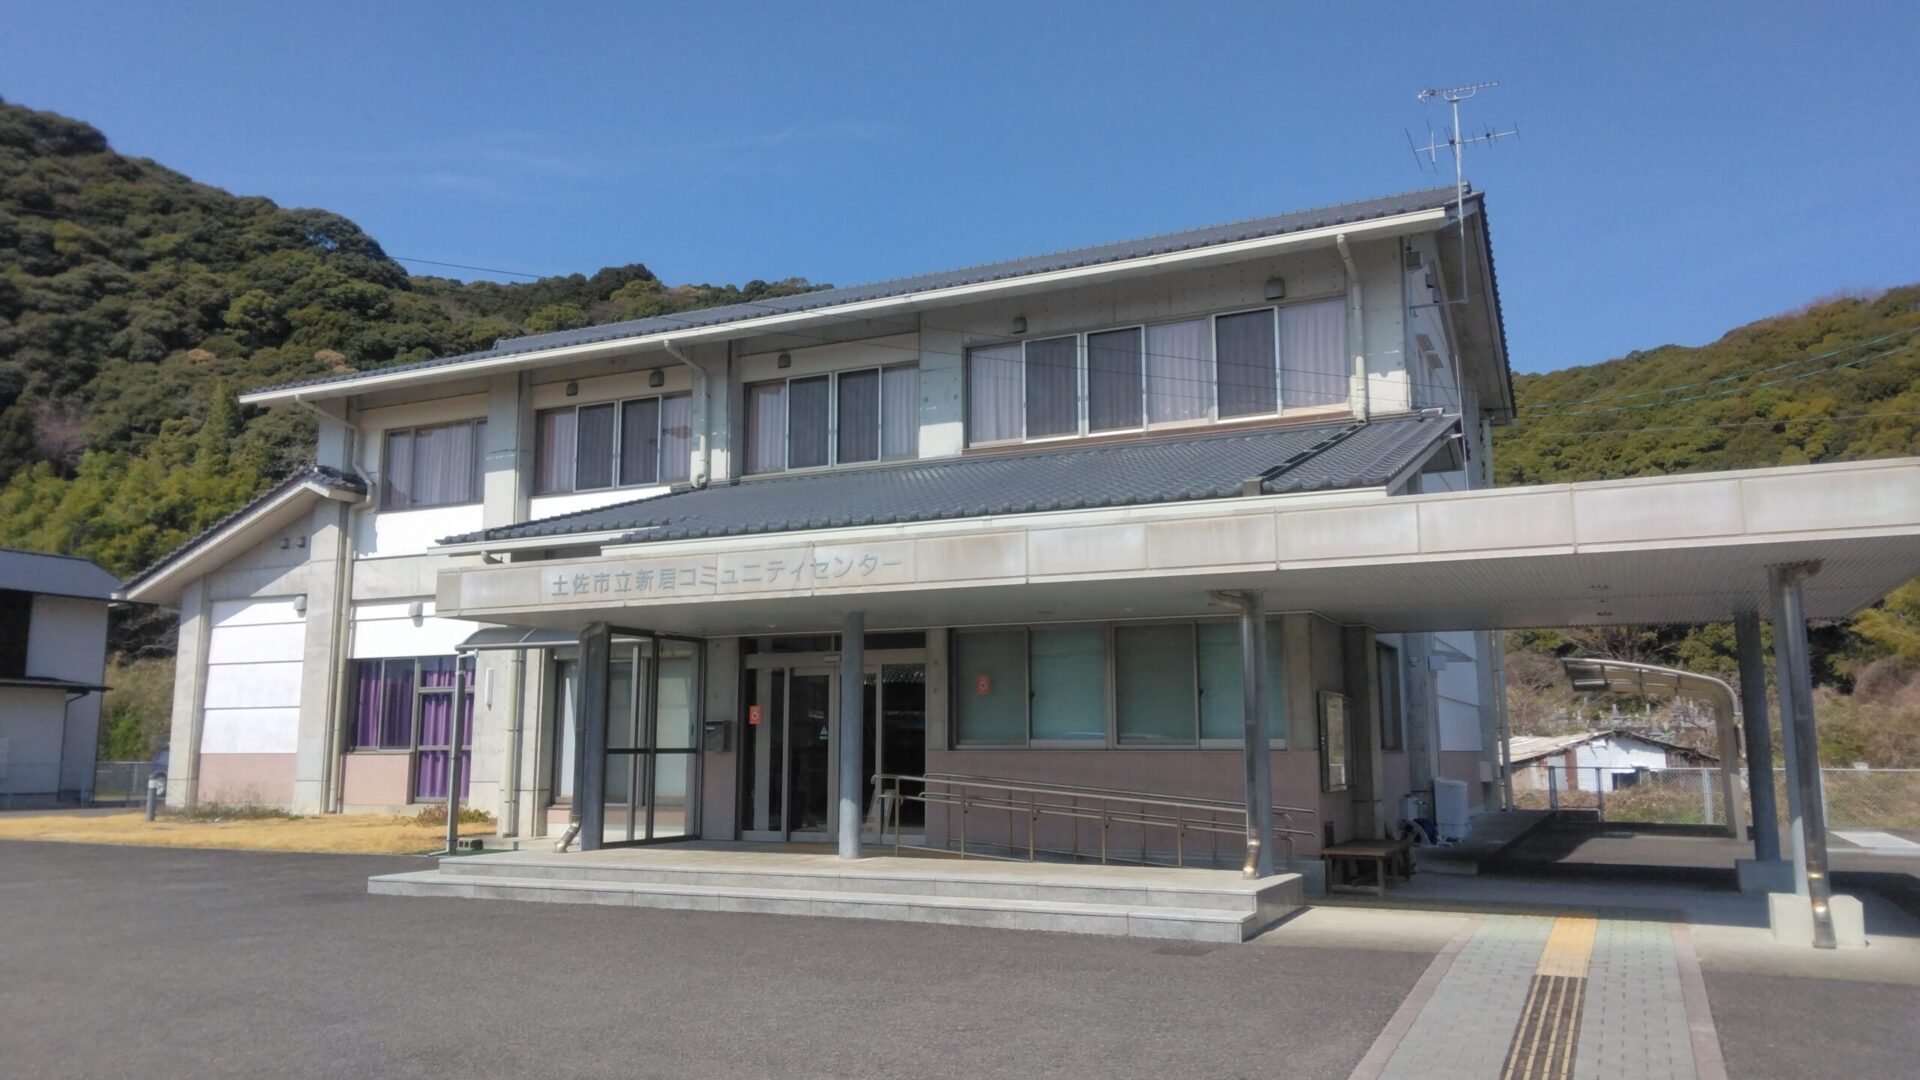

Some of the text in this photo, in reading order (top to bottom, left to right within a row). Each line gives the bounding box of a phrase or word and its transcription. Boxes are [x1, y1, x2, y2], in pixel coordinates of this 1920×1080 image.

[551, 554, 902, 596] 土佐市立新居コミュニティセンター
